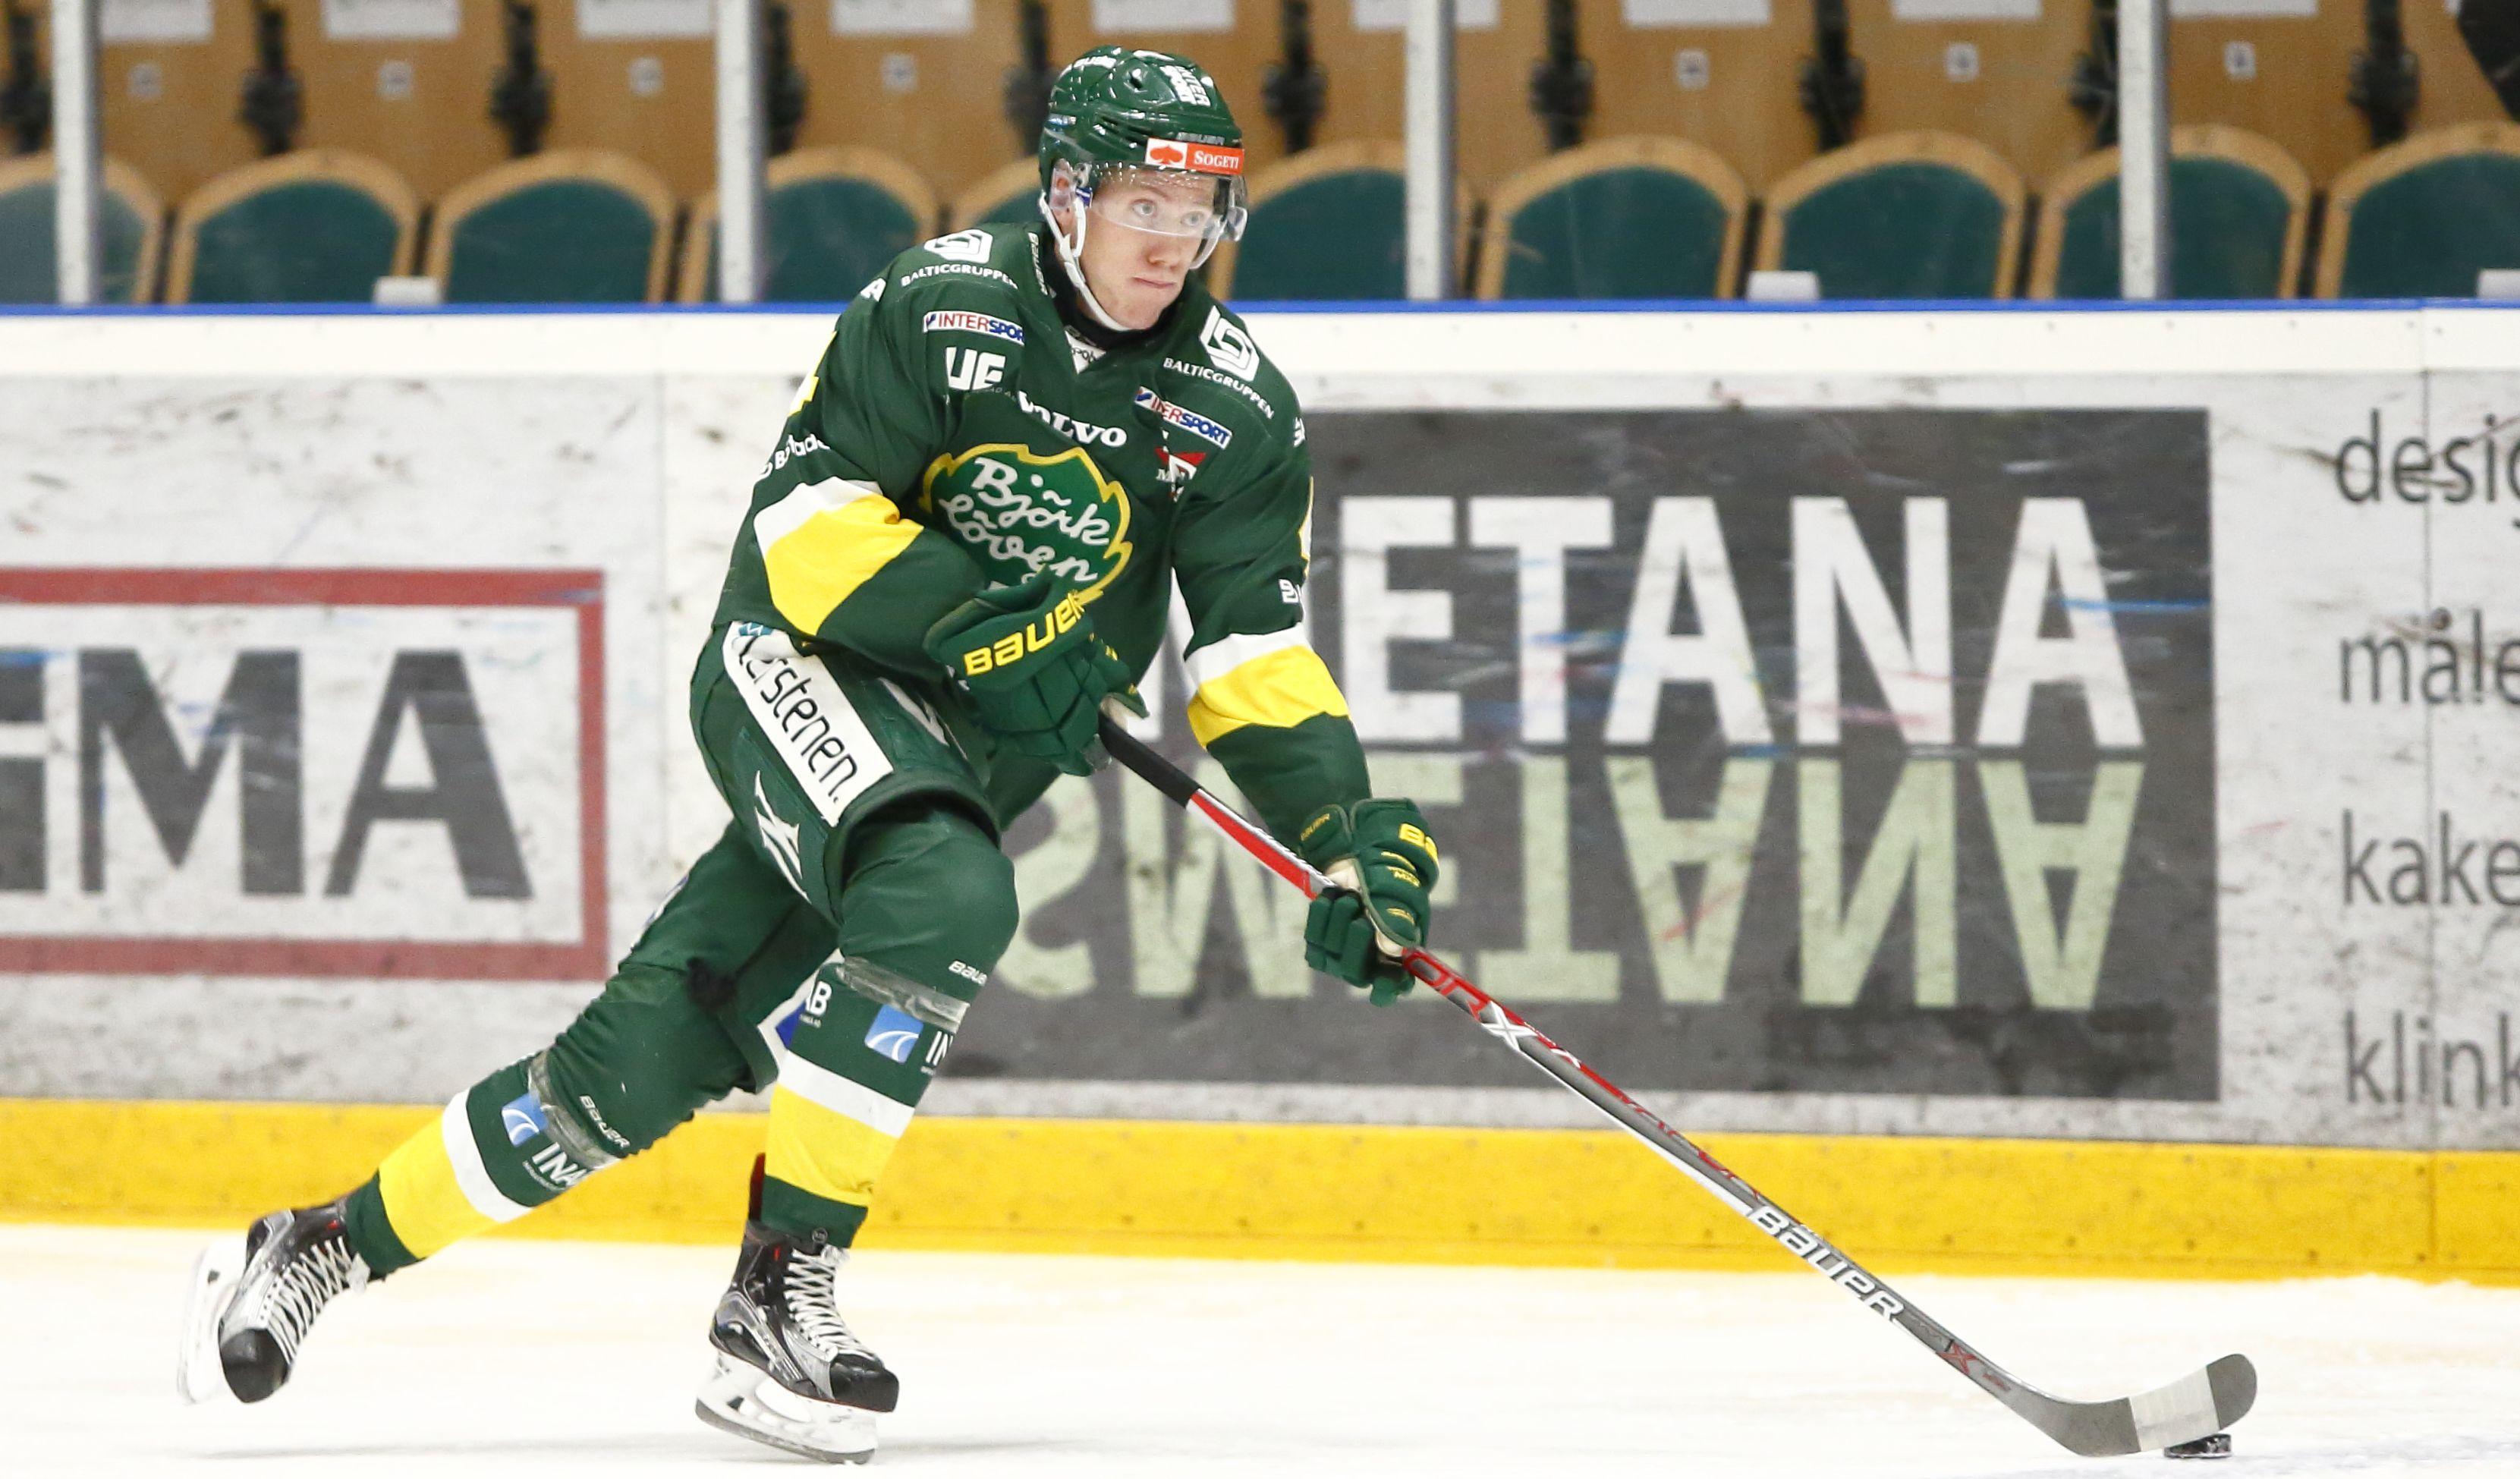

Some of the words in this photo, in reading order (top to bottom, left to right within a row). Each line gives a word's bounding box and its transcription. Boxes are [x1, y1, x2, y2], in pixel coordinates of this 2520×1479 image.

[1163, 357, 1275, 420] BALTICGRUPPEN
[1136, 496, 2145, 744] ETANA
[579, 1095, 631, 1148] BAUER
[1748, 1205, 1906, 1321] BAUER
